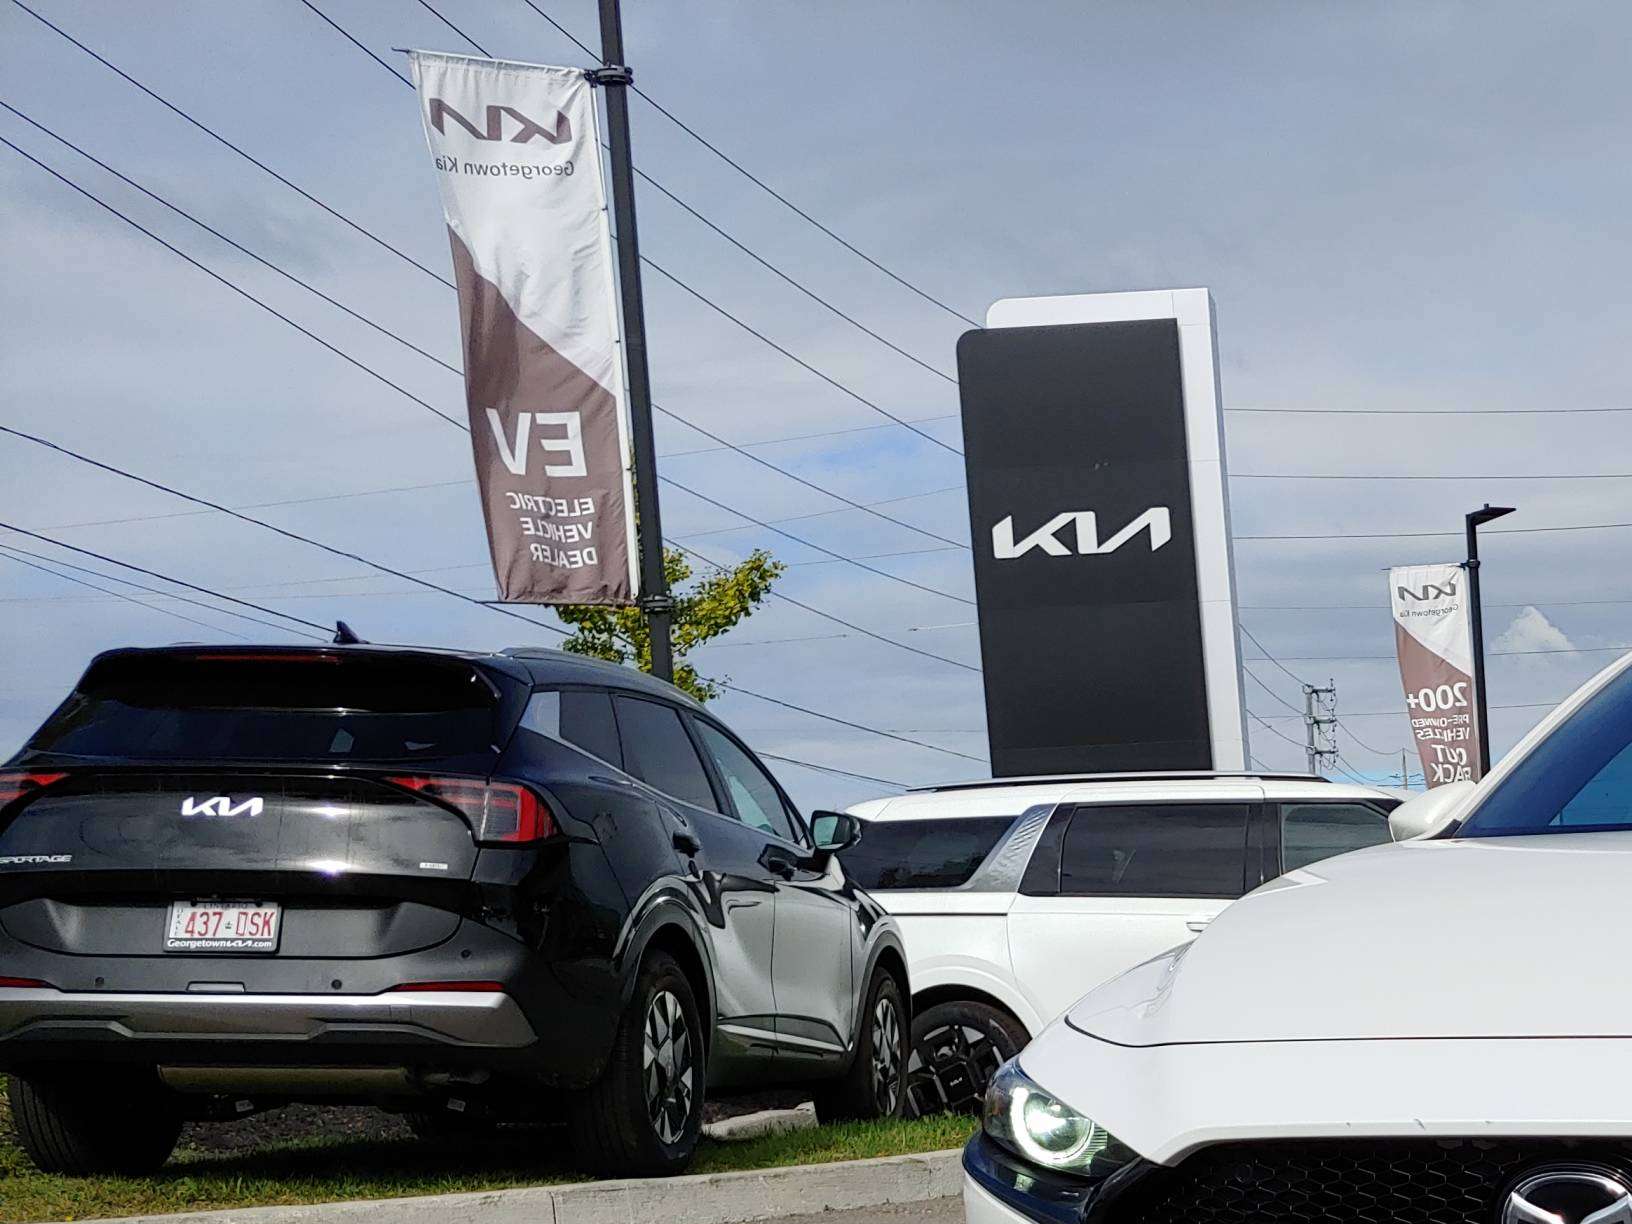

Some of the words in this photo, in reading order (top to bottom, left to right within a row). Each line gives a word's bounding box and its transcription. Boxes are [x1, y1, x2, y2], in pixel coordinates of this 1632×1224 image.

[991, 506, 1172, 559] KIA
[181, 797, 264, 817] KIA
[184, 911, 223, 937] 437
